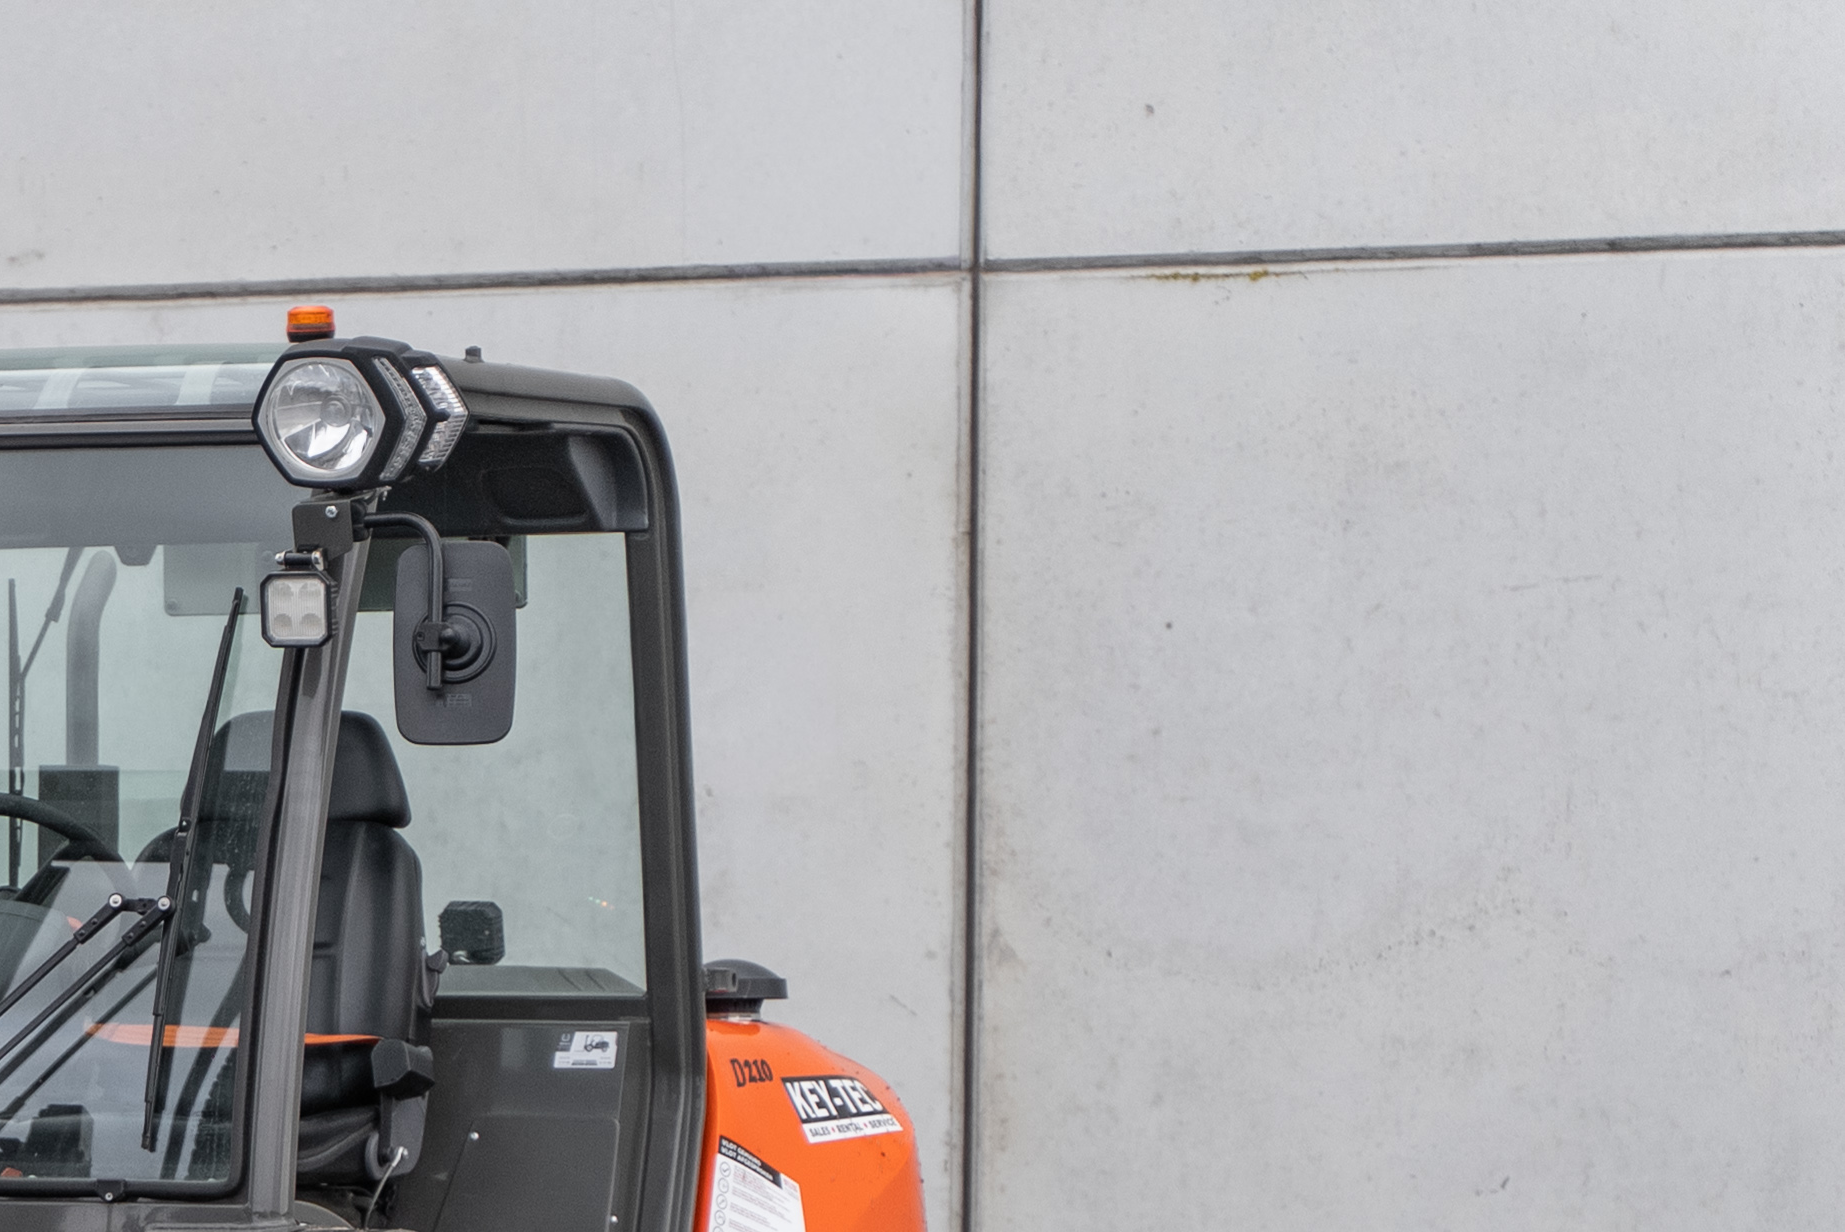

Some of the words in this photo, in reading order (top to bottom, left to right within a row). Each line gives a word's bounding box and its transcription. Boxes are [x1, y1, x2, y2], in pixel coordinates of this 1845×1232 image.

[730, 1058, 774, 1087] D210
[784, 1078, 884, 1120] KEY-TEC
[809, 1126, 831, 1138] SALES
[836, 1122, 863, 1133] RENTAL
[868, 1118, 897, 1129] SERVICE
